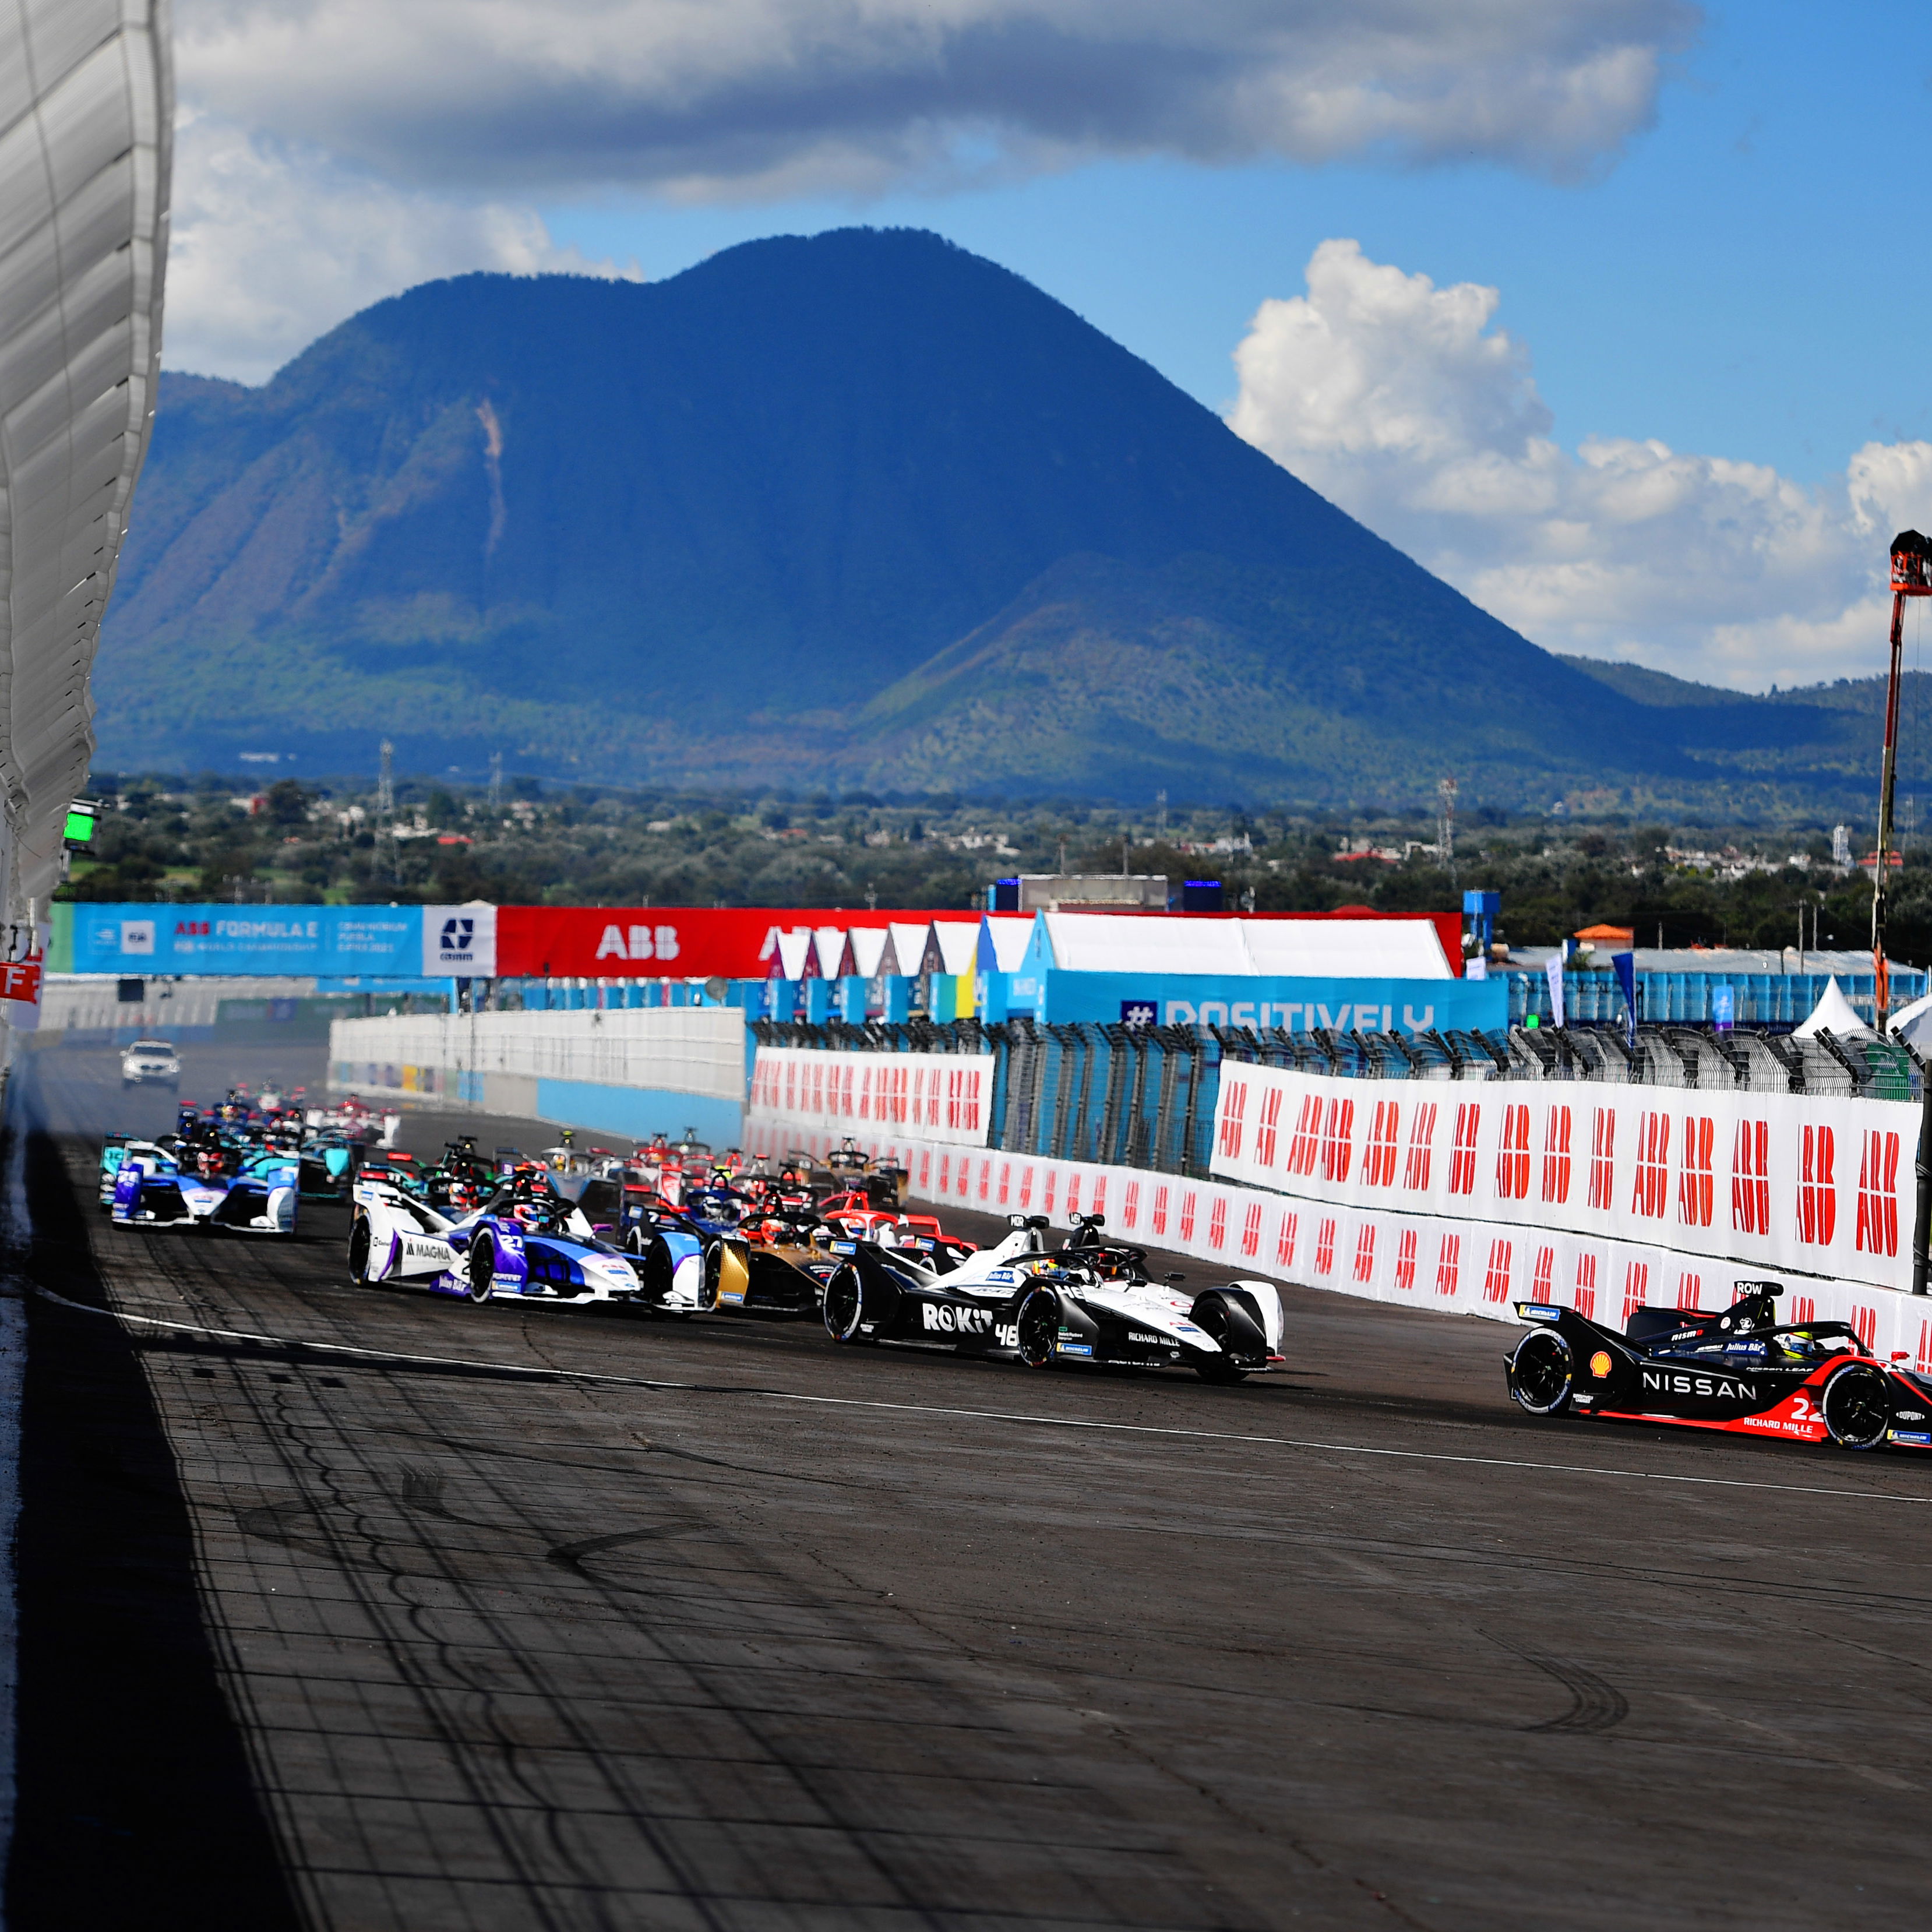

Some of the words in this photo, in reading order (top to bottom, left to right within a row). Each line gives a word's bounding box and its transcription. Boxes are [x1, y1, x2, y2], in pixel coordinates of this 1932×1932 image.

[175, 921, 209, 935] ABB
[216, 921, 302, 937] FORMULA
[595, 925, 681, 960] ABB
[1631, 1111, 1670, 1219] ABB
[1731, 1119, 1769, 1235] ABB
[1856, 1129, 1899, 1257] ABB
[500, 1235, 523, 1249] 27
[416, 1244, 450, 1260] MAGNA
[1737, 1282, 1762, 1295] ROW
[1128, 1331, 1158, 1344] RICHARD
[1159, 1336, 1180, 1347] MILLE
[1726, 1343, 1747, 1352] Julius
[1748, 1343, 1762, 1352] Bär
[1642, 1372, 1757, 1401] NISSAN
[1899, 1411, 1922, 1420] DUPONT
[1744, 1417, 1781, 1429] RICHARD
[1783, 1422, 1814, 1434] MILLE
